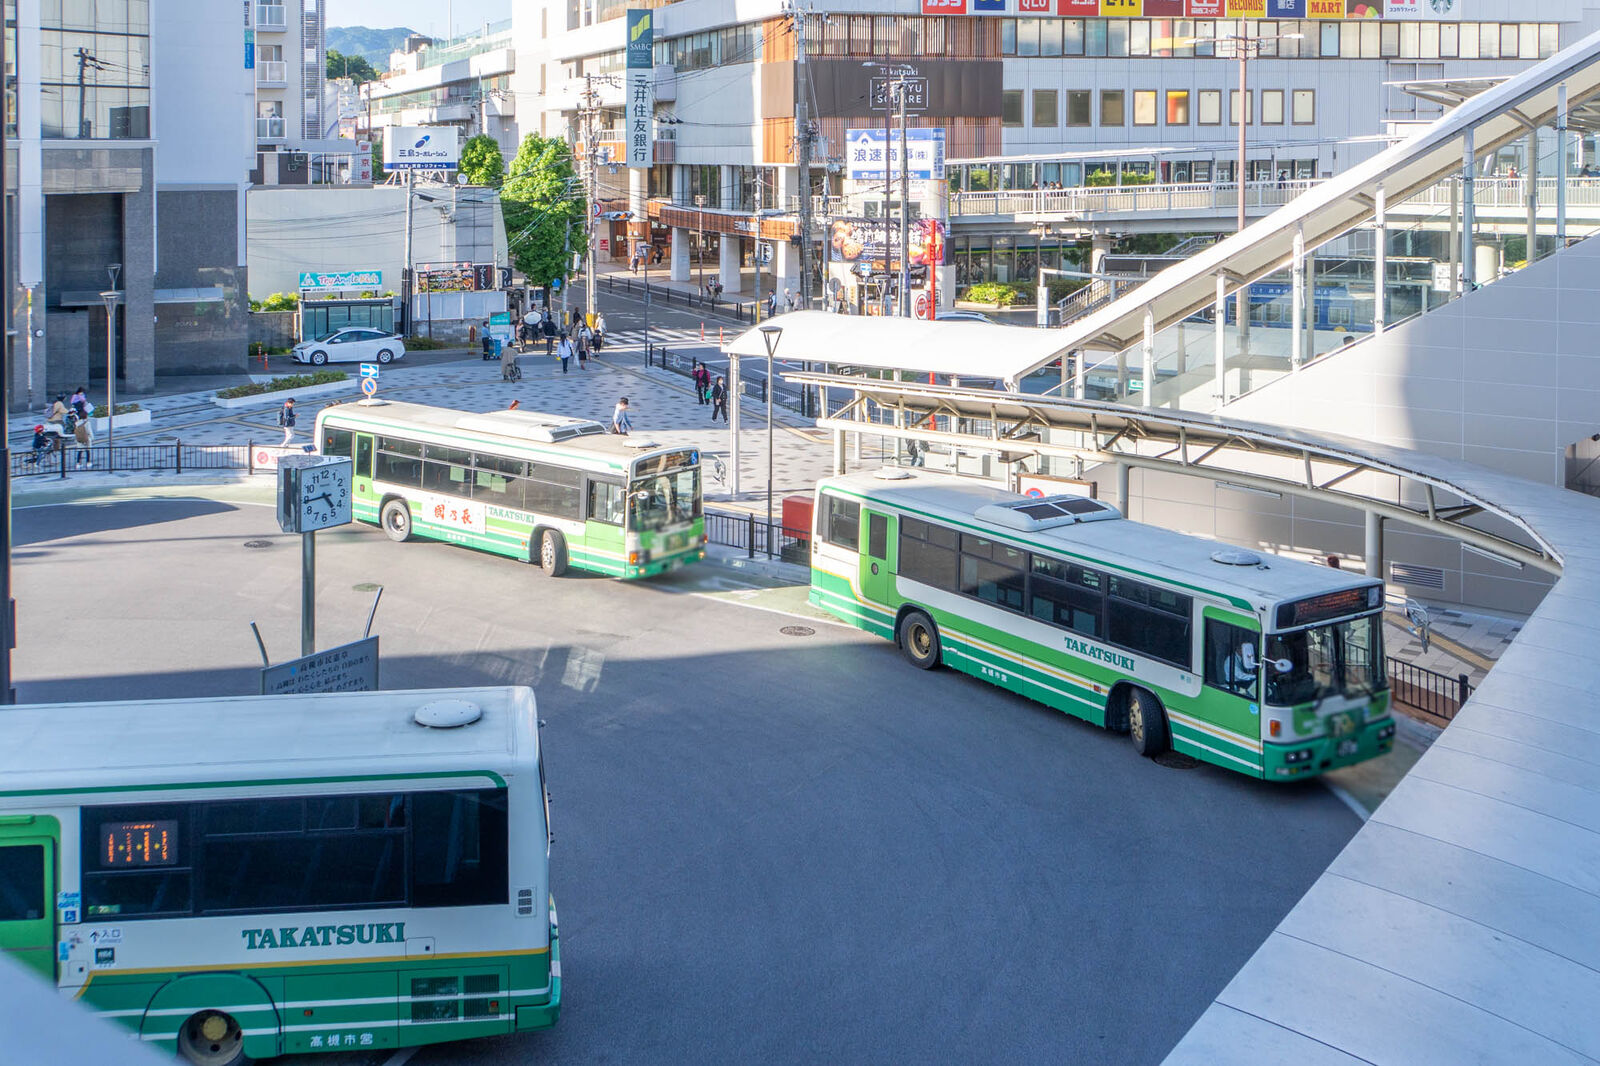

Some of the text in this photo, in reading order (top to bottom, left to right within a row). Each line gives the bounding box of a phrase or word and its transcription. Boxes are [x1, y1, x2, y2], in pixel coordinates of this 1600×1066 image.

[1311, 2, 1342, 13] MART
[633, 74, 647, 162] 三井住友銀行
[321, 470, 329, 479] 12
[312, 475, 319, 484] 11
[337, 478, 343, 487] 2
[306, 484, 314, 493] 10
[340, 489, 346, 497] 3
[307, 506, 312, 515] 8
[330, 508, 336, 517] 5
[488, 506, 535, 524] TAKATSUKI
[313, 512, 319, 521] 7
[322, 513, 327, 522] 6
[1064, 636, 1135, 671] TAKATSUKI
[102, 929, 121, 938] 入口
[242, 922, 406, 949] TAKATSUKI
